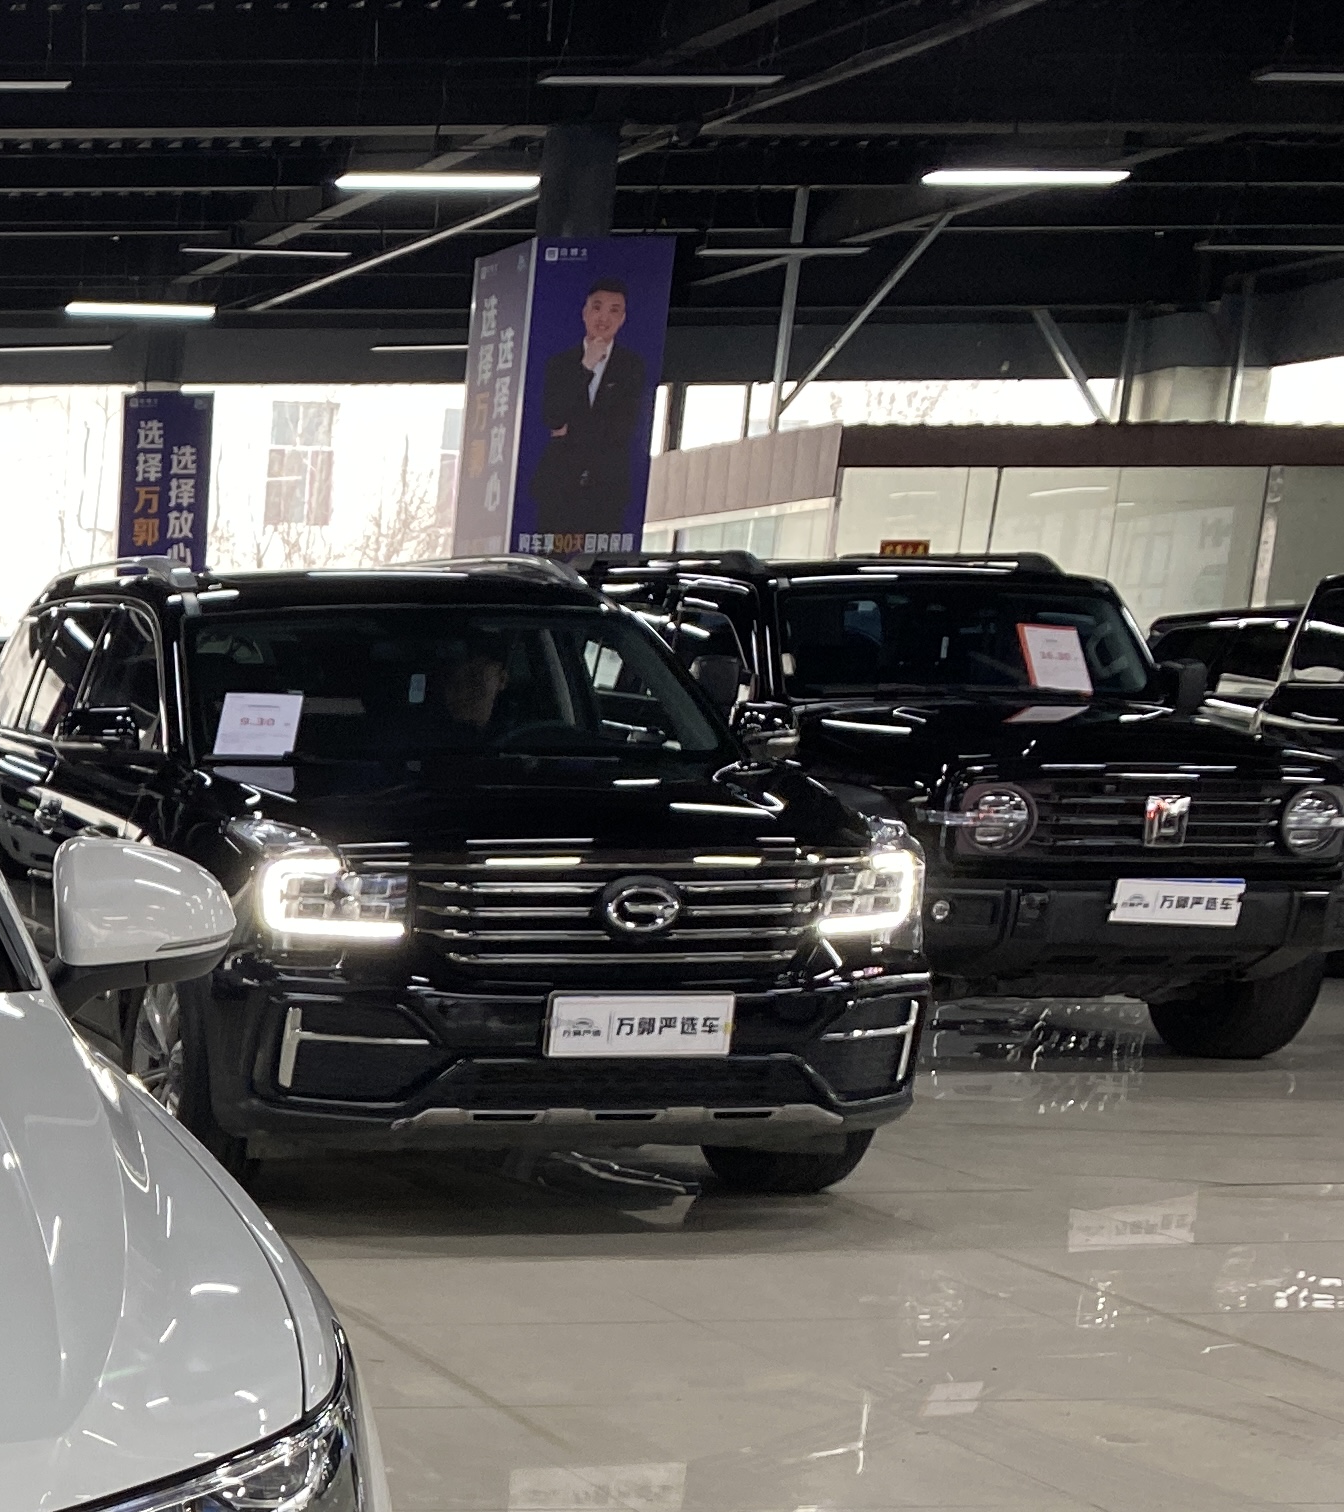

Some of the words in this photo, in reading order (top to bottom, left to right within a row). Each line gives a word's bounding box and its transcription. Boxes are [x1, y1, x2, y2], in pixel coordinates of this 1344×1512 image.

[132, 420, 164, 546] 选择万郭
[166, 445, 197, 568] 选择放心
[615, 1016, 720, 1036] 万郭严选车
